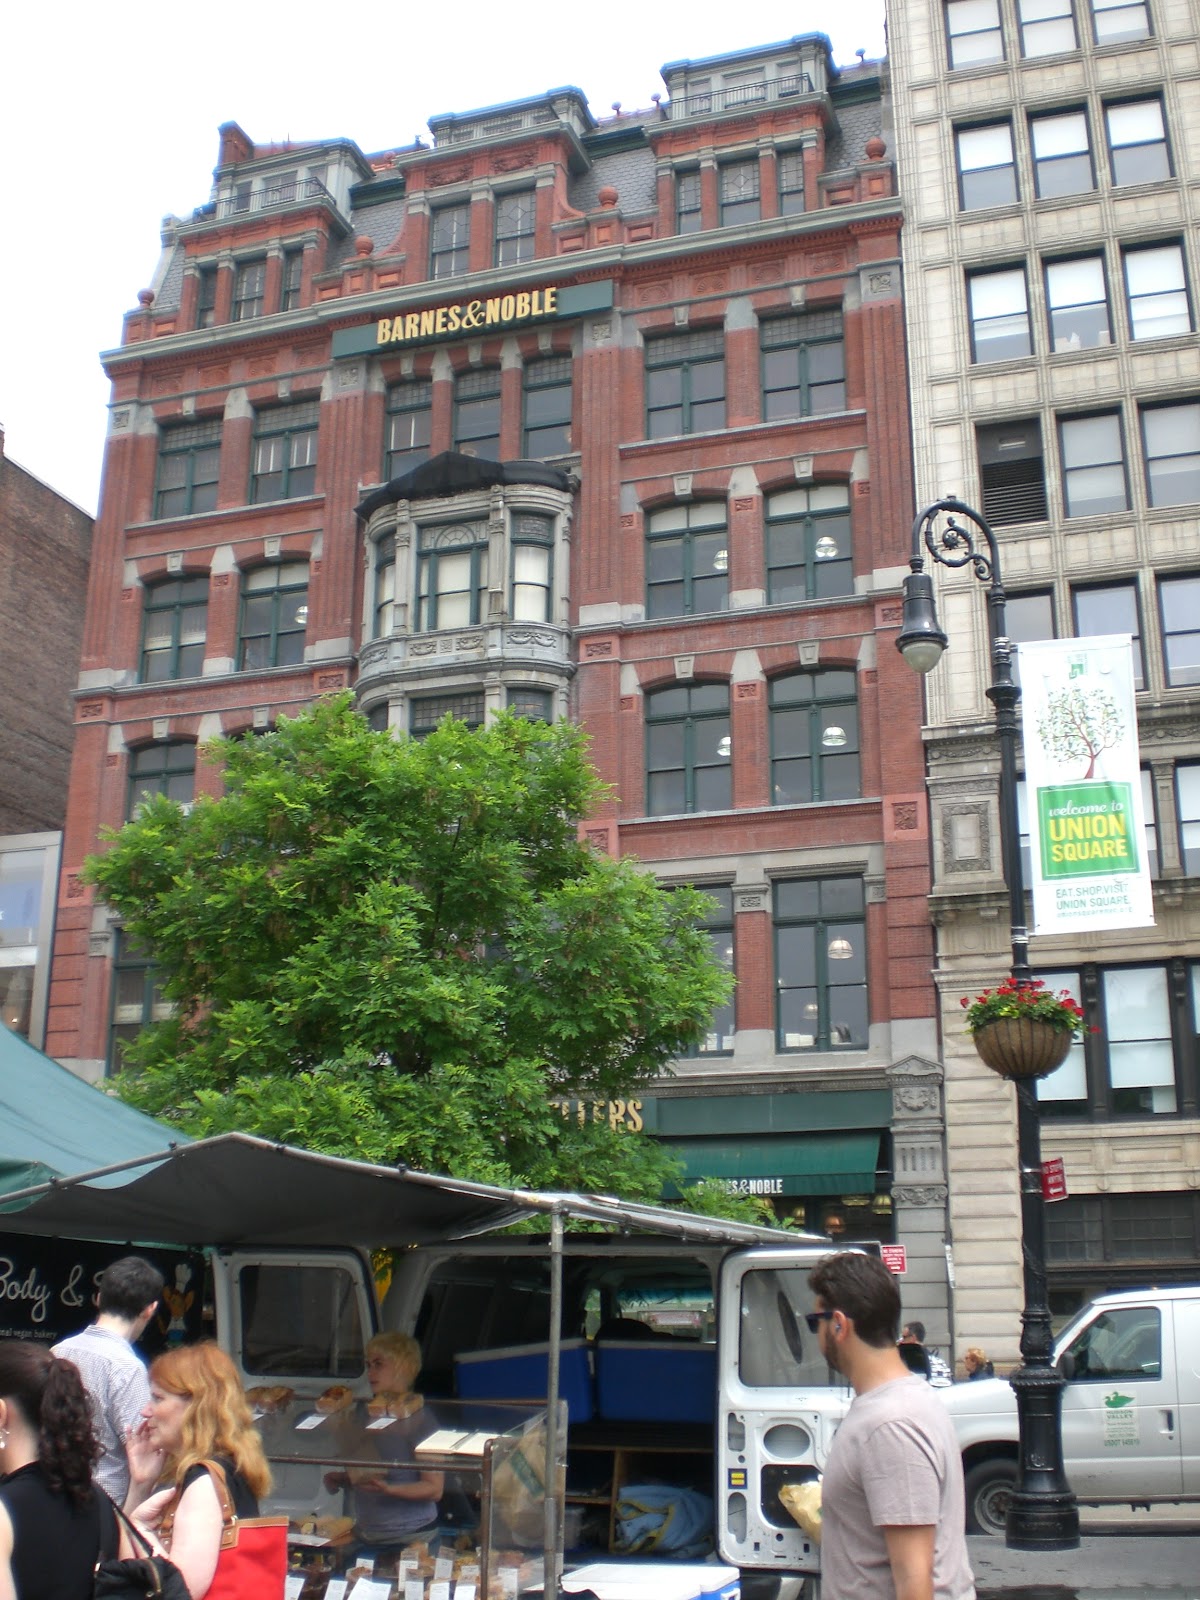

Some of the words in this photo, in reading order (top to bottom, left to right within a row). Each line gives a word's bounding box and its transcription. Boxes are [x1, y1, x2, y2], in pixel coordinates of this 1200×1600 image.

[377, 286, 558, 346] BARNES&NOBLE
[1049, 800, 1107, 816] welcome
[1111, 800, 1124, 812] to
[1050, 813, 1126, 842] UNION
[1052, 838, 1128, 862] SQUARE
[1056, 899, 1087, 910] UNION
[1089, 895, 1130, 907] SQUARE
[60, 1264, 84, 1307] &
